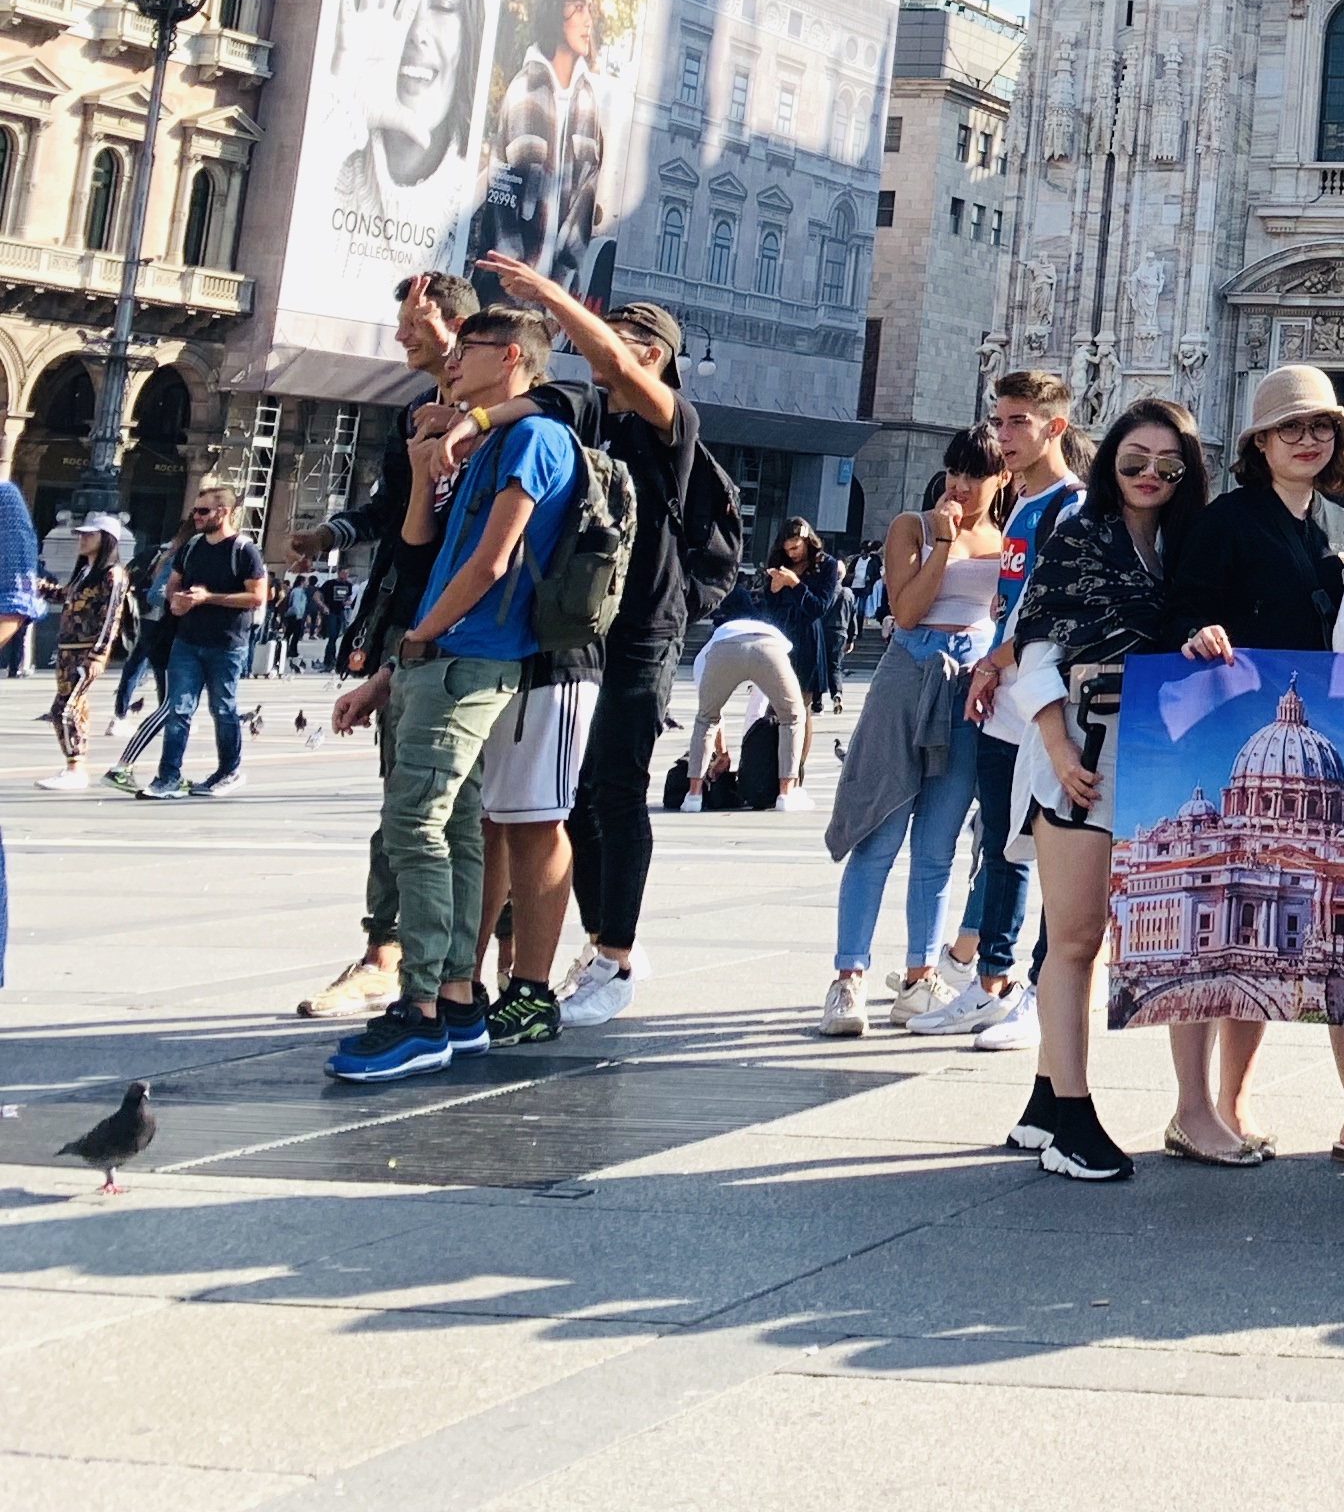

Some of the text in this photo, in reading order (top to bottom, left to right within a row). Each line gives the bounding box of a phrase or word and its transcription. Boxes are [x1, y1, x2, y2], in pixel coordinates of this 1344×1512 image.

[332, 208, 436, 249] CONSCIOUS
[350, 241, 413, 265] COLLECTION
[62, 457, 89, 466] ROCC
[1000, 544, 1026, 573] ete
